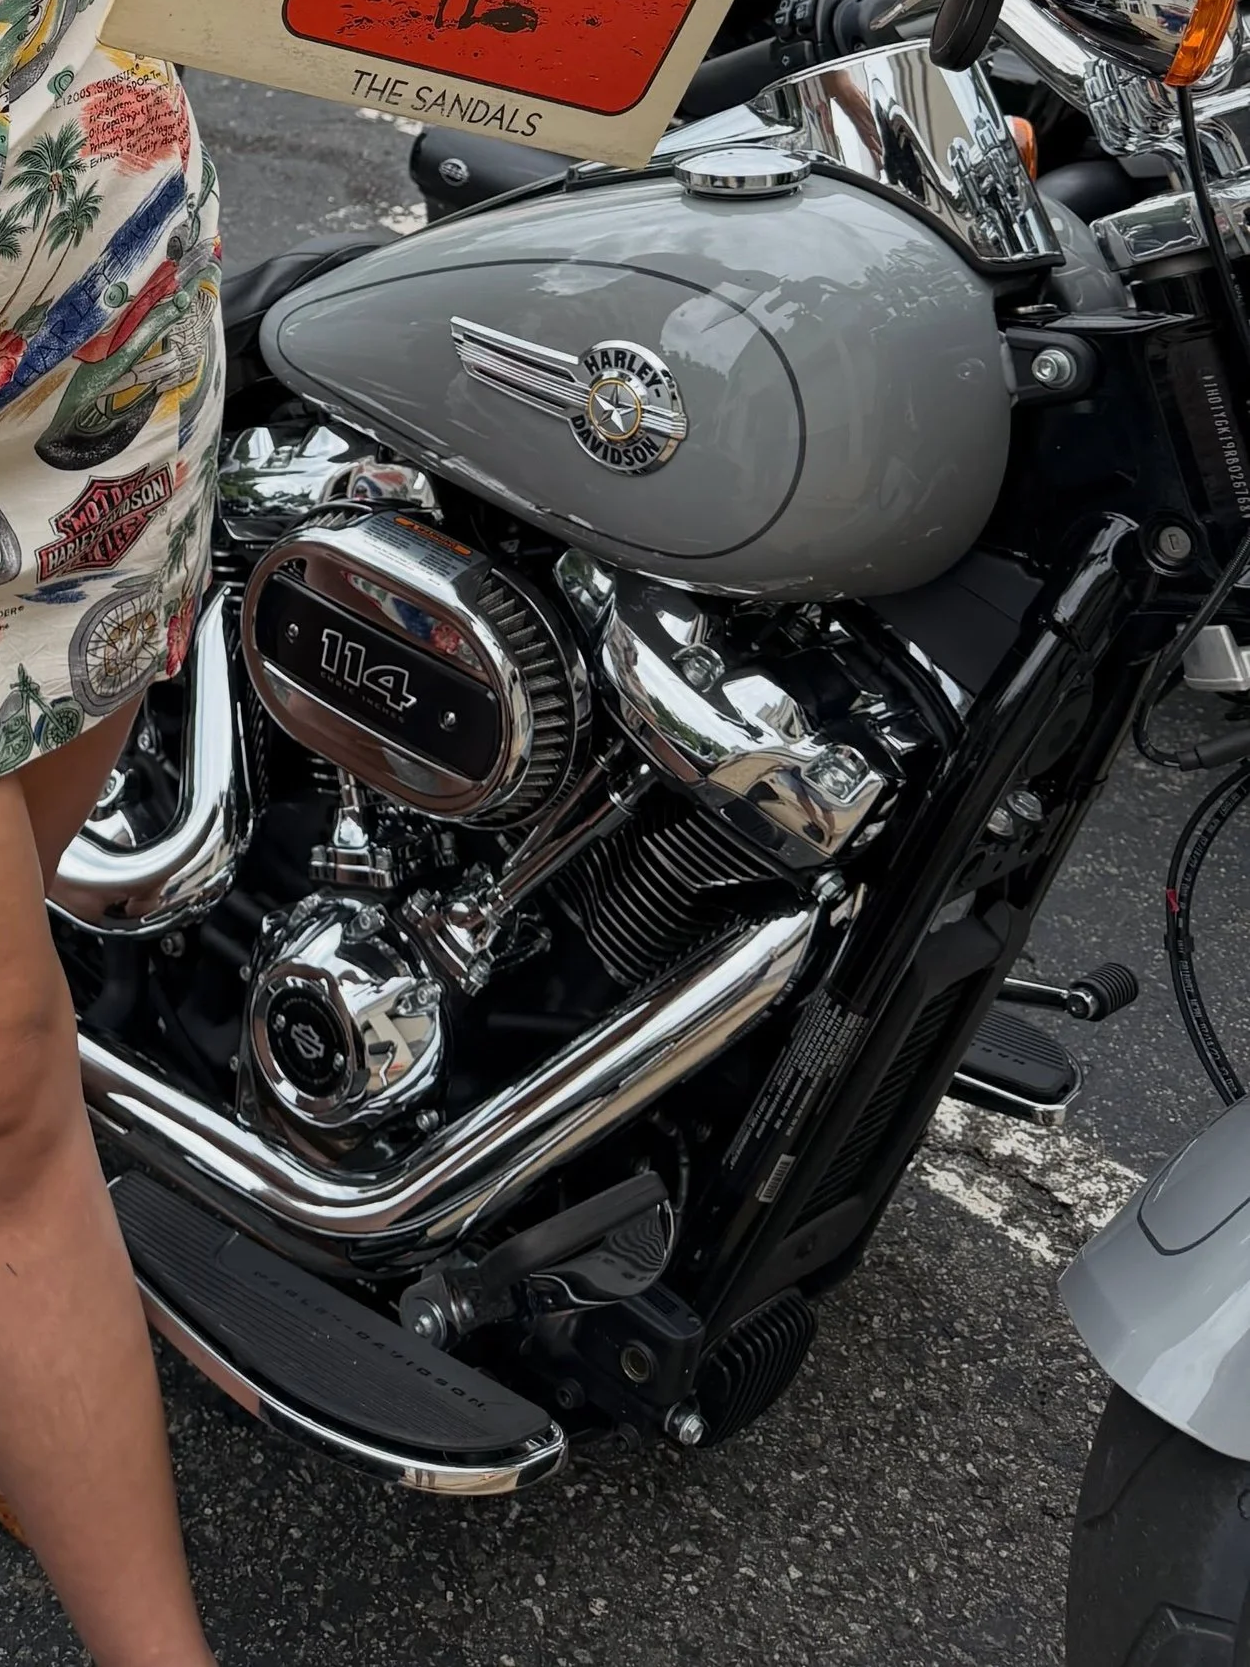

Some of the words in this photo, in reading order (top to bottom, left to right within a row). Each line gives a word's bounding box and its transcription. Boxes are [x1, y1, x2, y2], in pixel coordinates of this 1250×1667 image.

[351, 69, 409, 106] THE
[410, 85, 543, 137] SANDALS
[570, 414, 661, 467] DAVIDSON
[321, 628, 417, 712] 114
